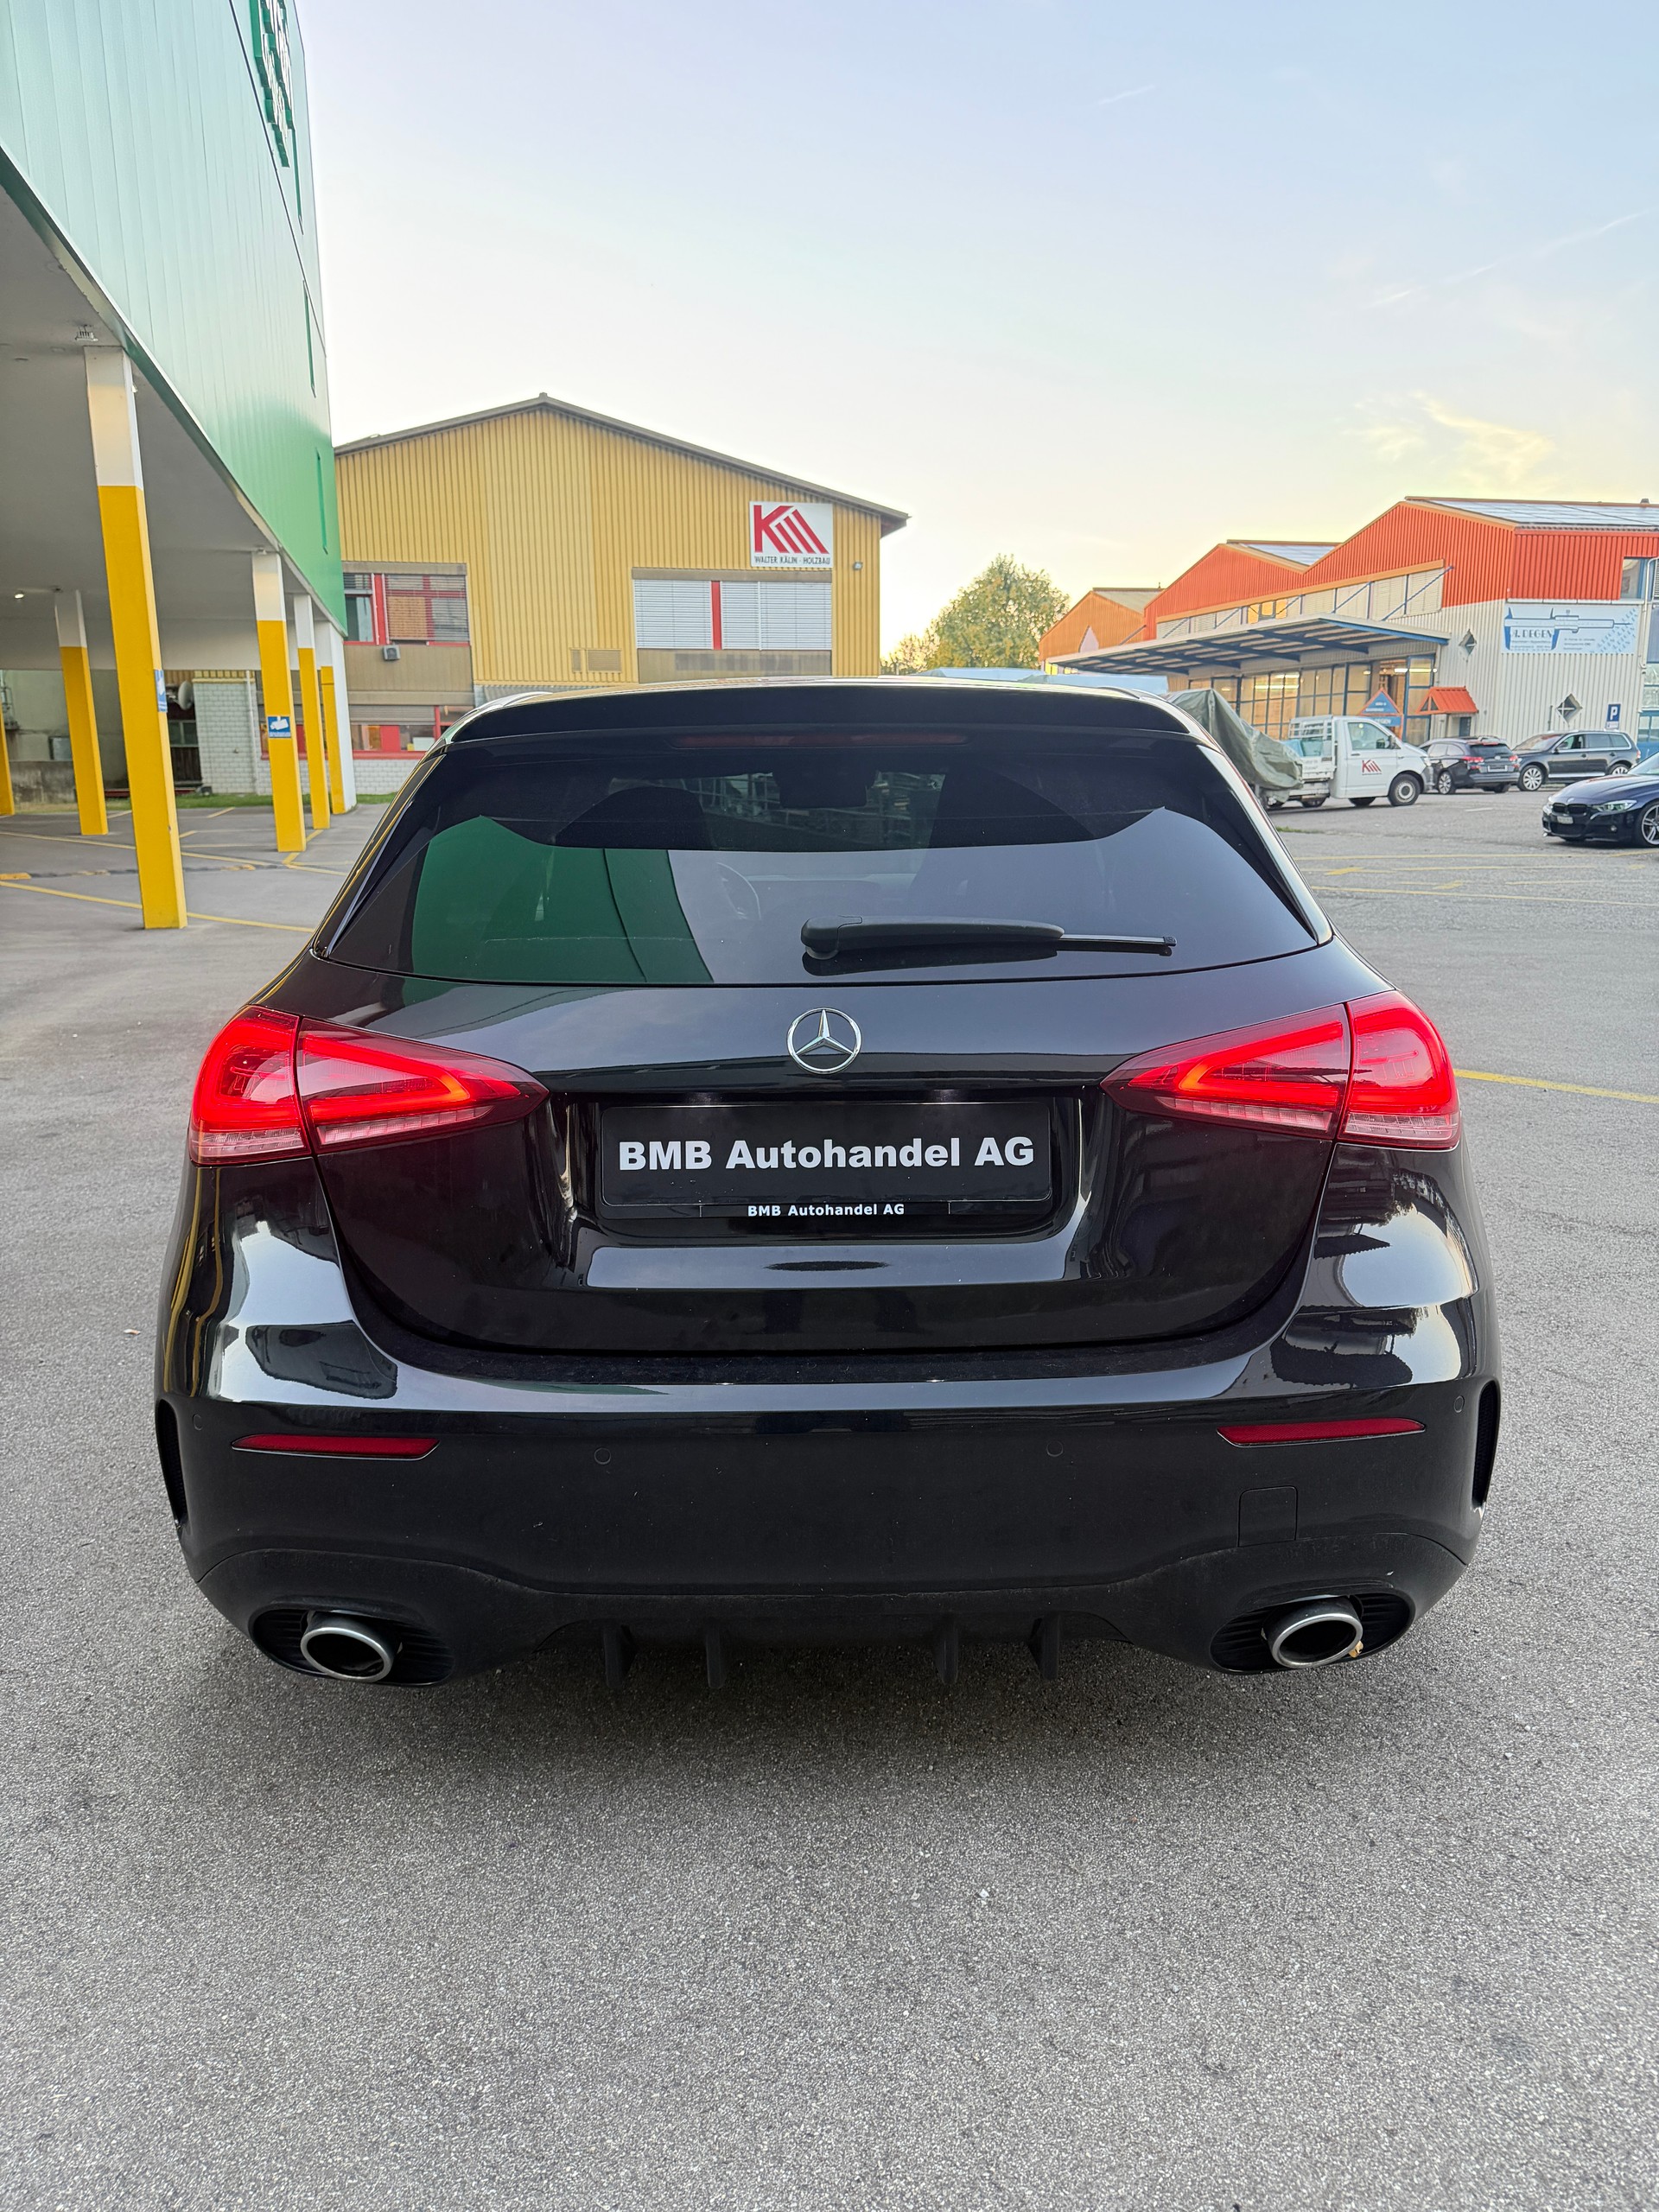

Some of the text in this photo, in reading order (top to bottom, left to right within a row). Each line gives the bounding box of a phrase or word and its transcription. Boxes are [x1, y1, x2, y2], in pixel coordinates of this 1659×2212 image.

[754, 556, 778, 564] WALTER
[1522, 629, 1553, 639] DEGEN
[1610, 706, 1618, 721] P
[618, 1136, 1034, 1172] BMB Autohandel AG
[747, 1204, 905, 1217] BMB Autohandel AG
